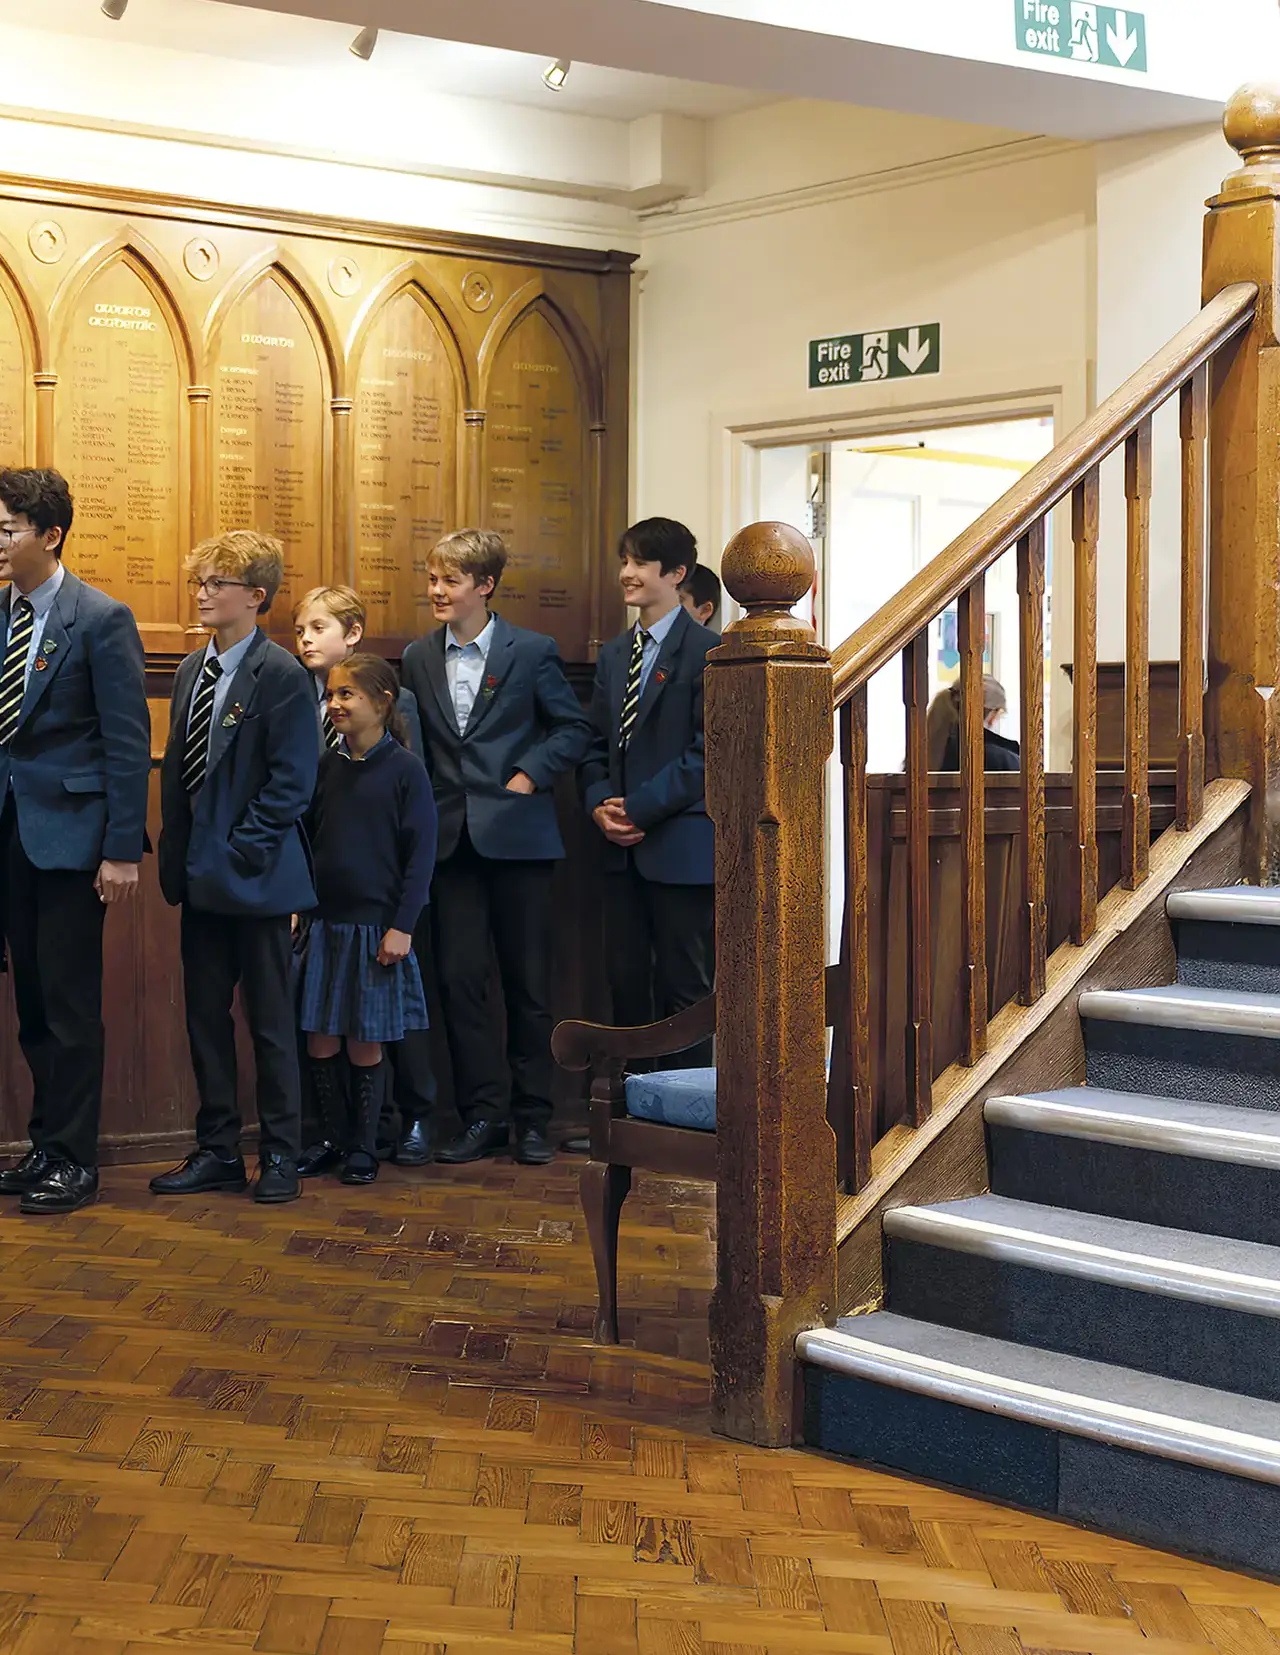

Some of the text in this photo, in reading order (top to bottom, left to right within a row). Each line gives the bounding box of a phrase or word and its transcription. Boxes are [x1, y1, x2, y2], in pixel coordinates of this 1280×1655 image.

[1023, 0, 1060, 25] Fire
[1025, 27, 1060, 52] exit
[817, 342, 852, 362] Fire
[818, 361, 850, 383] exit
